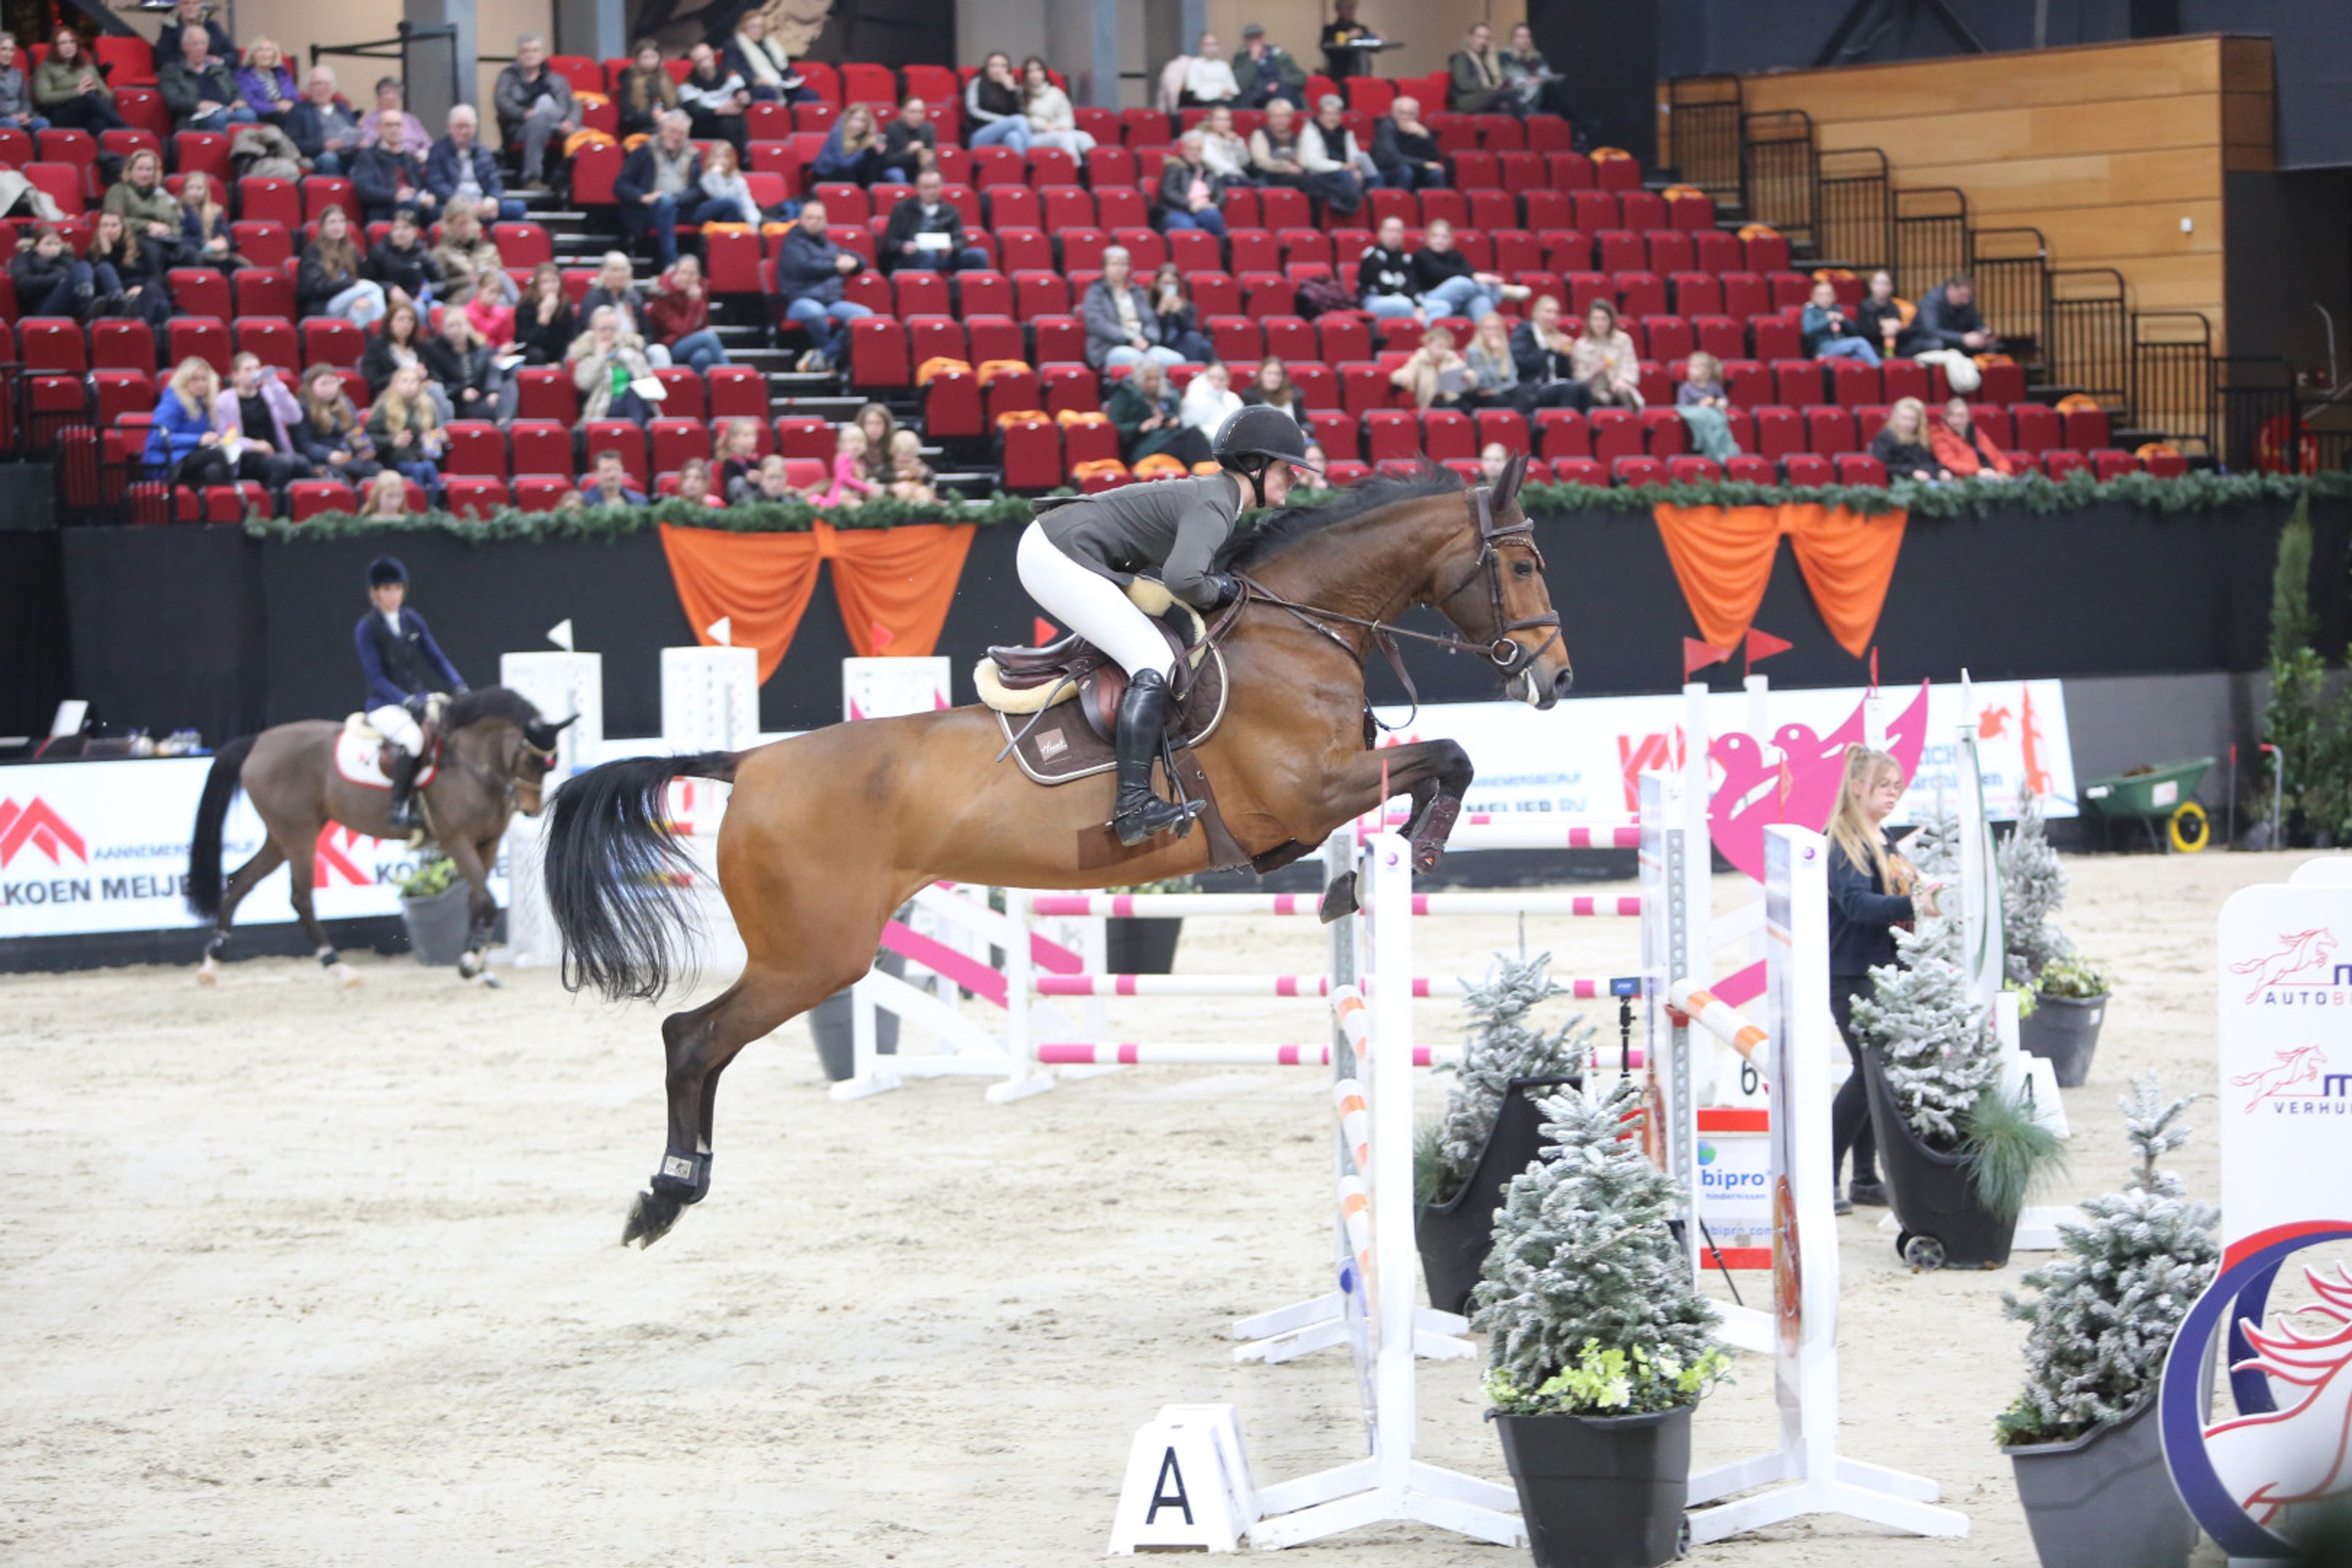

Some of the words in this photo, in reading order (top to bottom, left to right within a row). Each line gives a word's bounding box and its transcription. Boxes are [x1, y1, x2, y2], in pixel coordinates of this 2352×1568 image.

[4, 878, 91, 905] KOEN
[102, 873, 195, 901] MEIJE
[2265, 991, 2352, 1006] AUTOB
[1741, 1059, 1758, 1096] 6
[2274, 1102, 2352, 1114] VERHU
[1145, 1446, 1194, 1525] A
